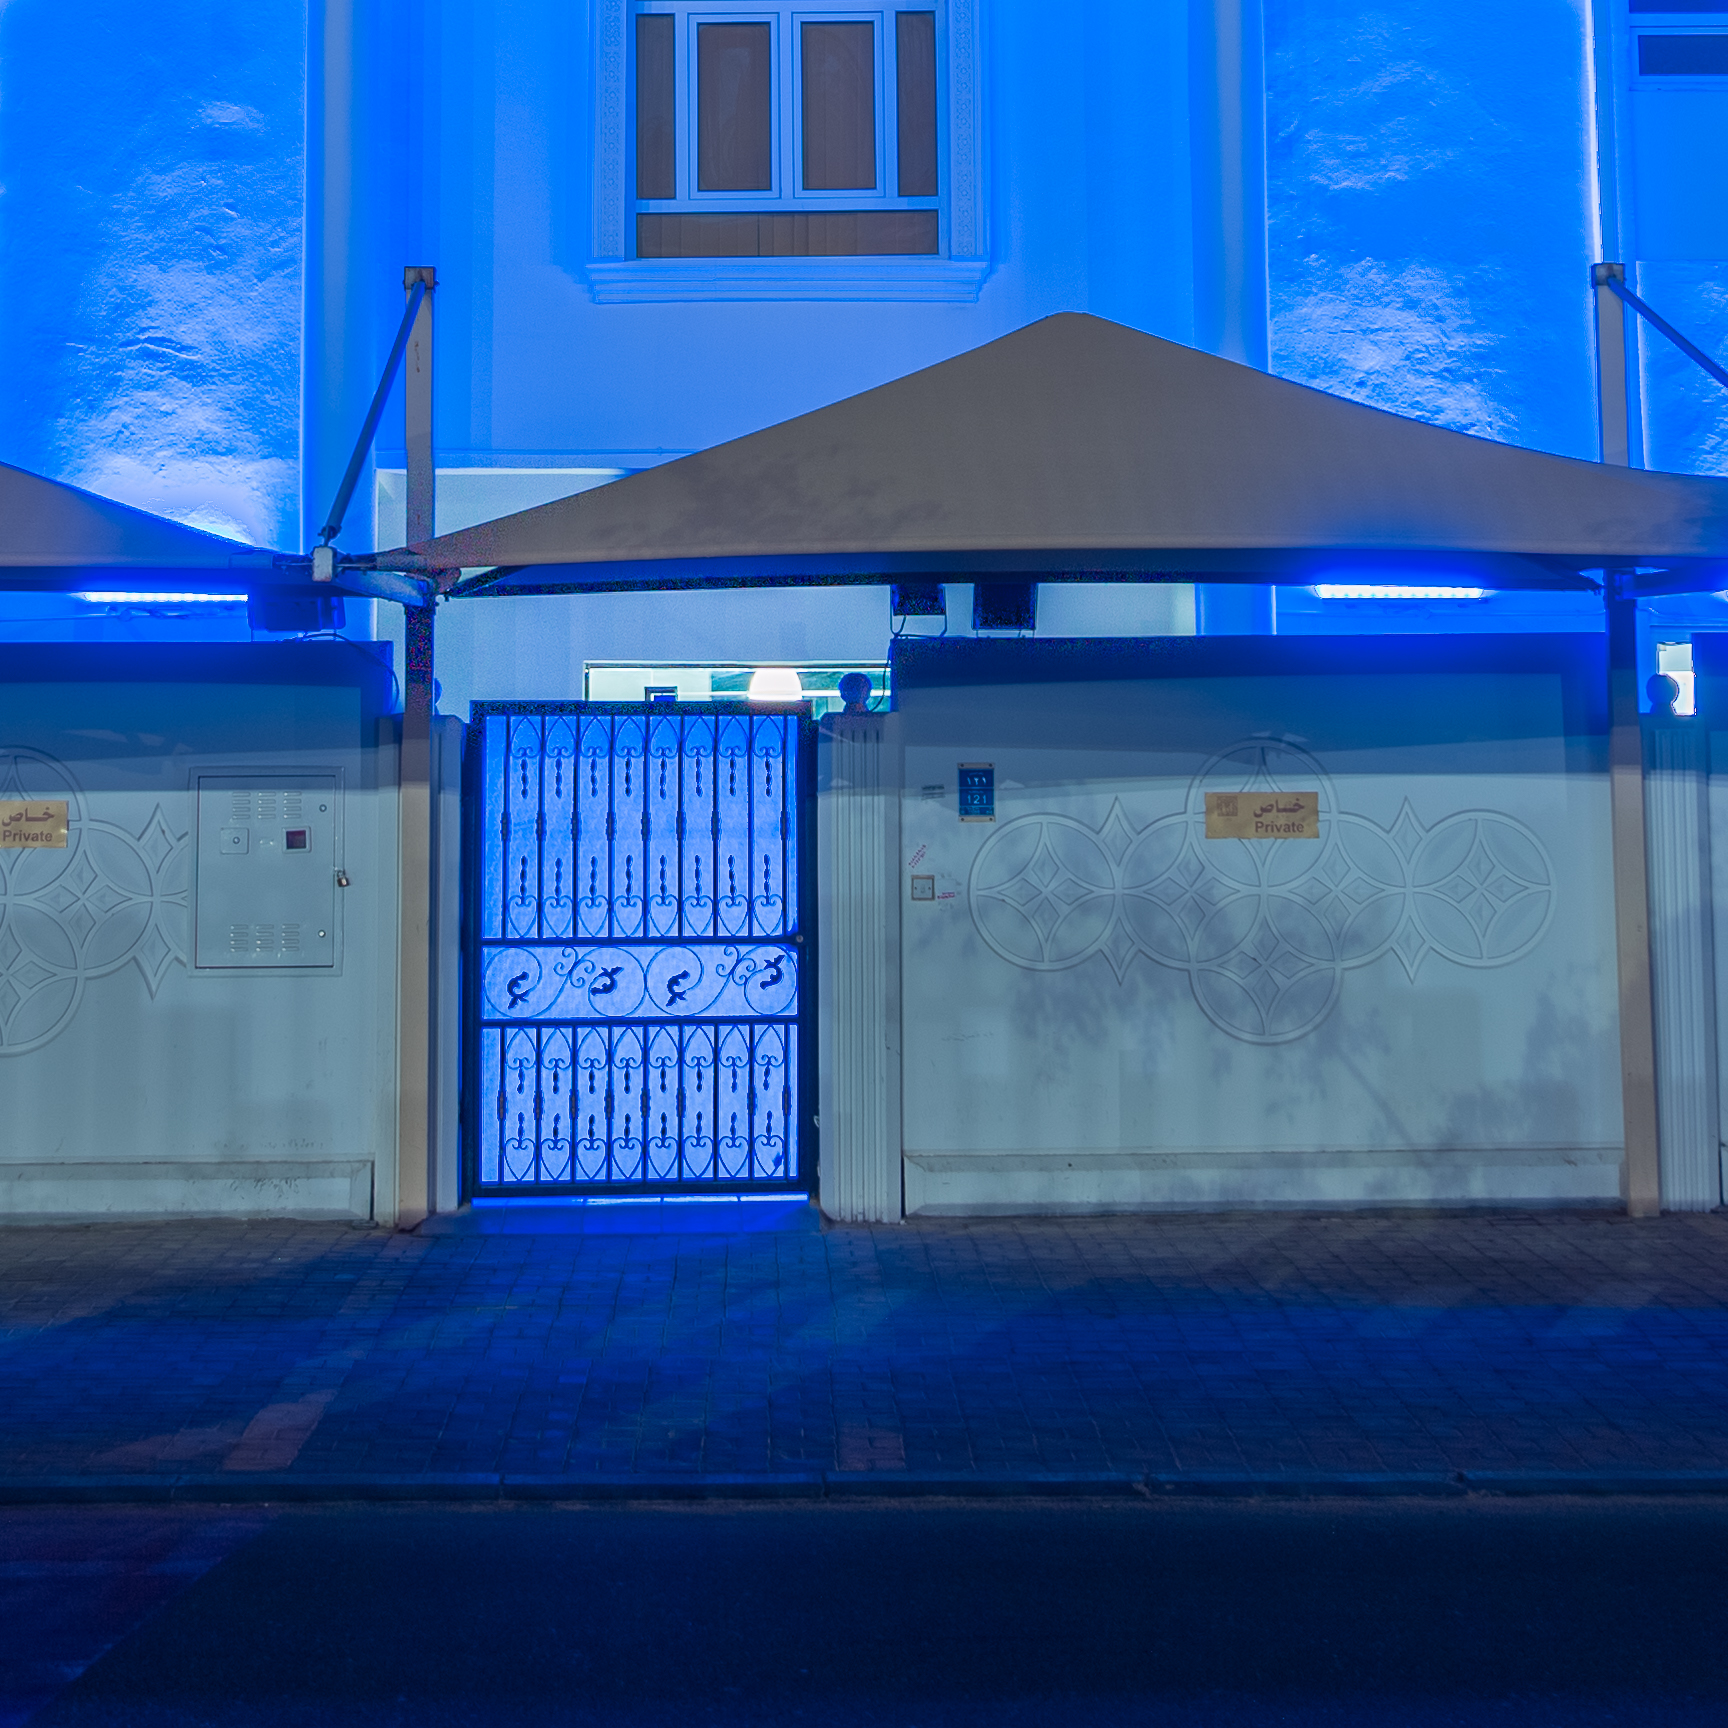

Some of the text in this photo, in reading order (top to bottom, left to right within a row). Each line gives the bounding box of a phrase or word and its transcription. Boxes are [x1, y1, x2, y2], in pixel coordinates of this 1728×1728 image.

[967, 794, 987, 804] 121
[1253, 798, 1305, 818] خاص
[2, 807, 55, 826] خاص
[1255, 821, 1304, 833] Private
[3, 830, 52, 842] Private
